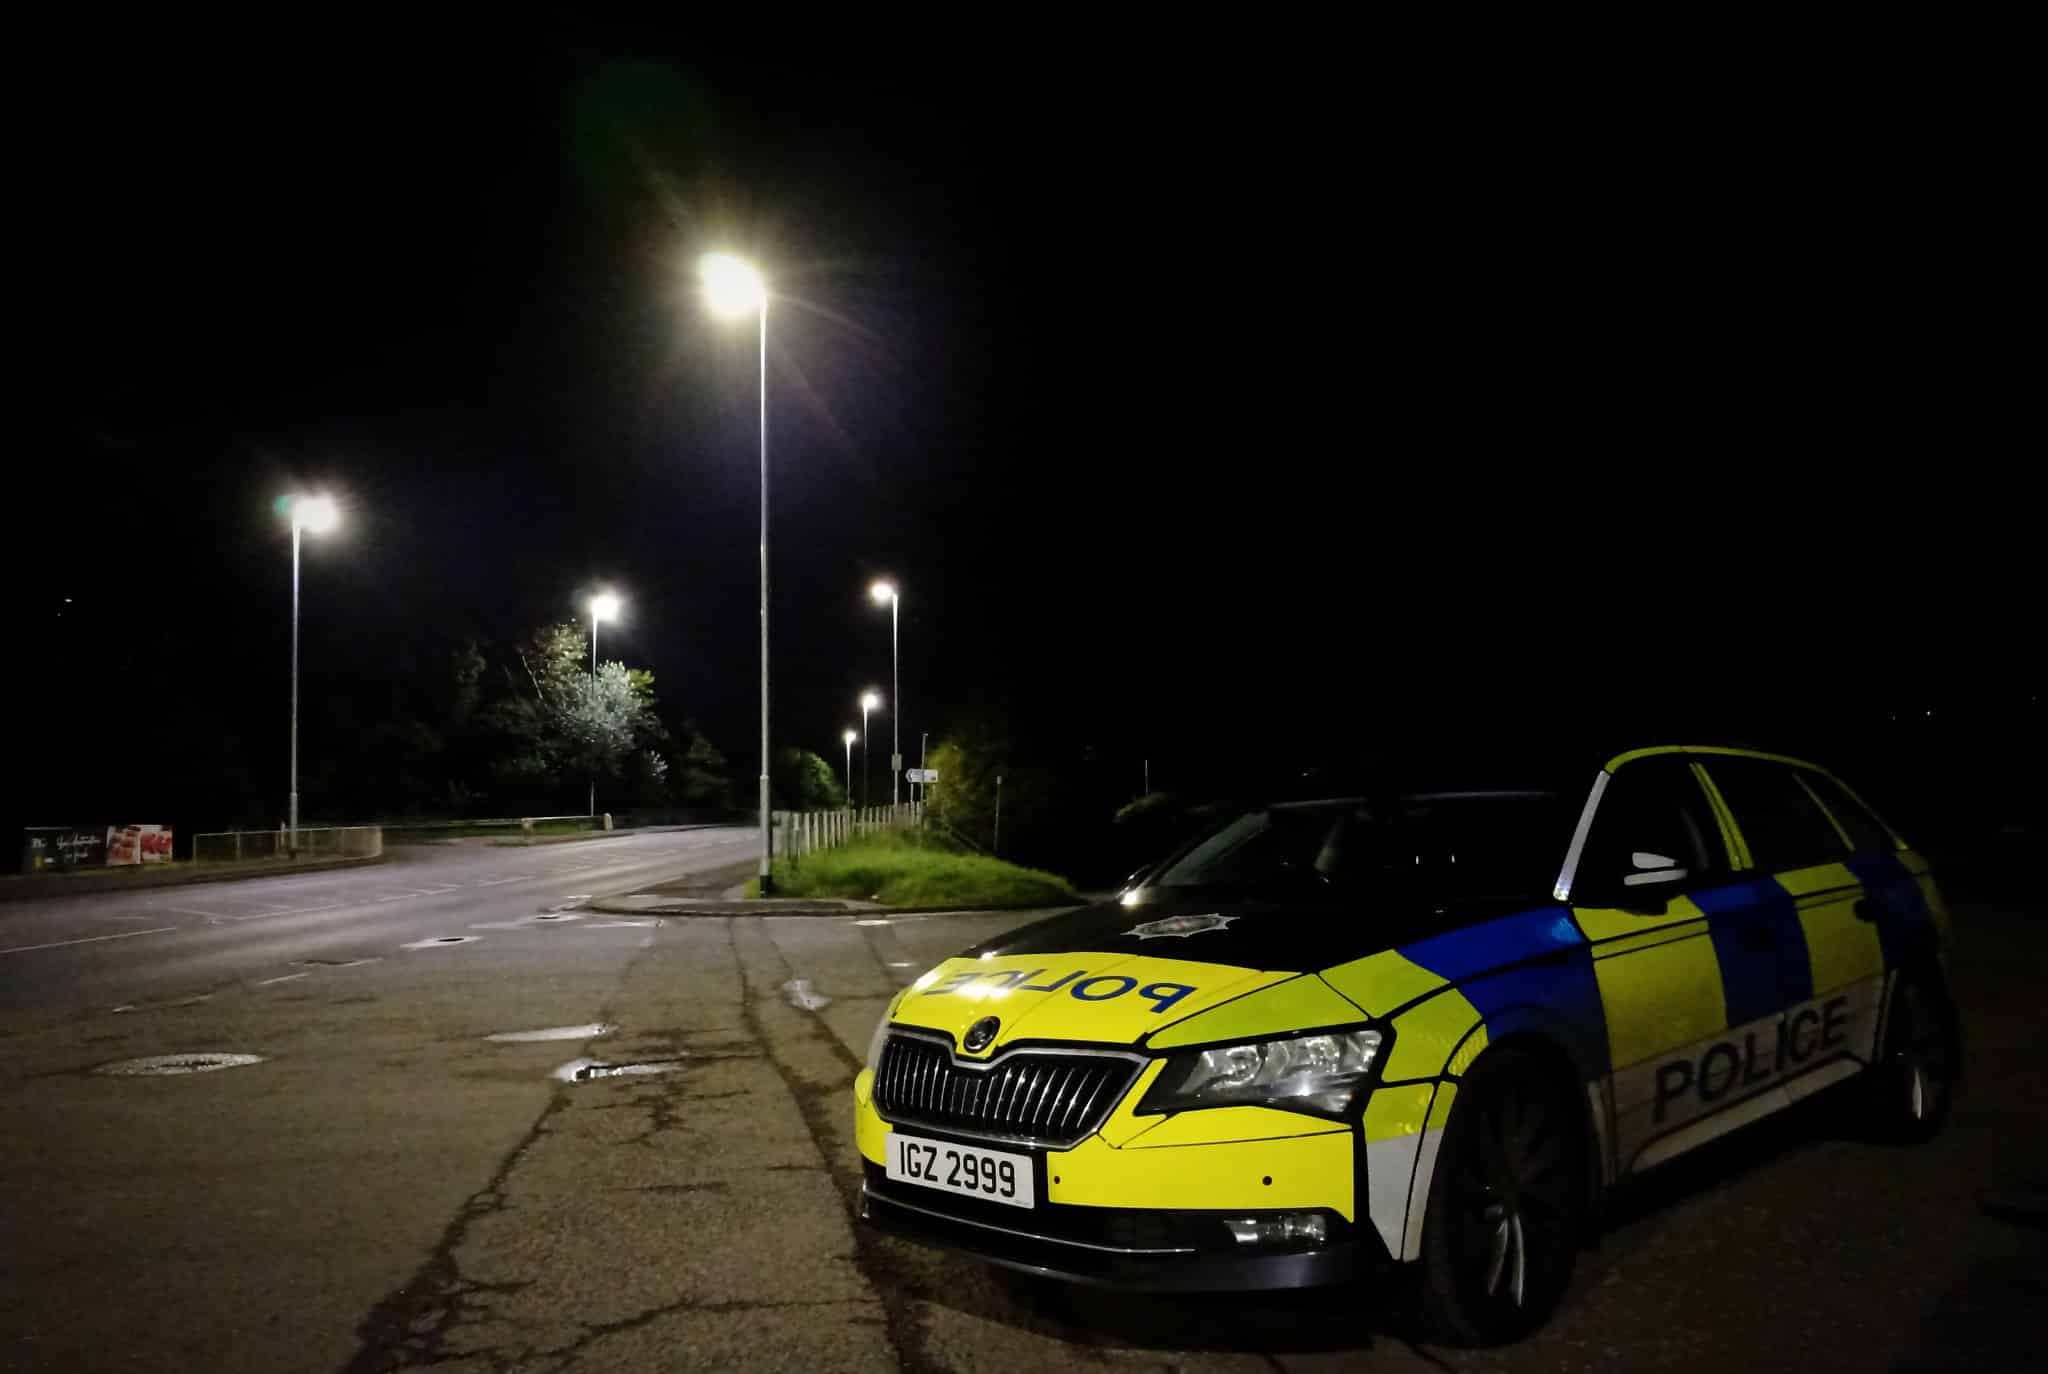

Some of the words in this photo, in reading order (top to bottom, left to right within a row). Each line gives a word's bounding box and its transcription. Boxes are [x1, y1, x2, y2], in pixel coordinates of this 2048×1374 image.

[1653, 996, 1848, 1123] POLICE
[900, 1141, 938, 1182] IGZ
[946, 1150, 1015, 1198] 2999
